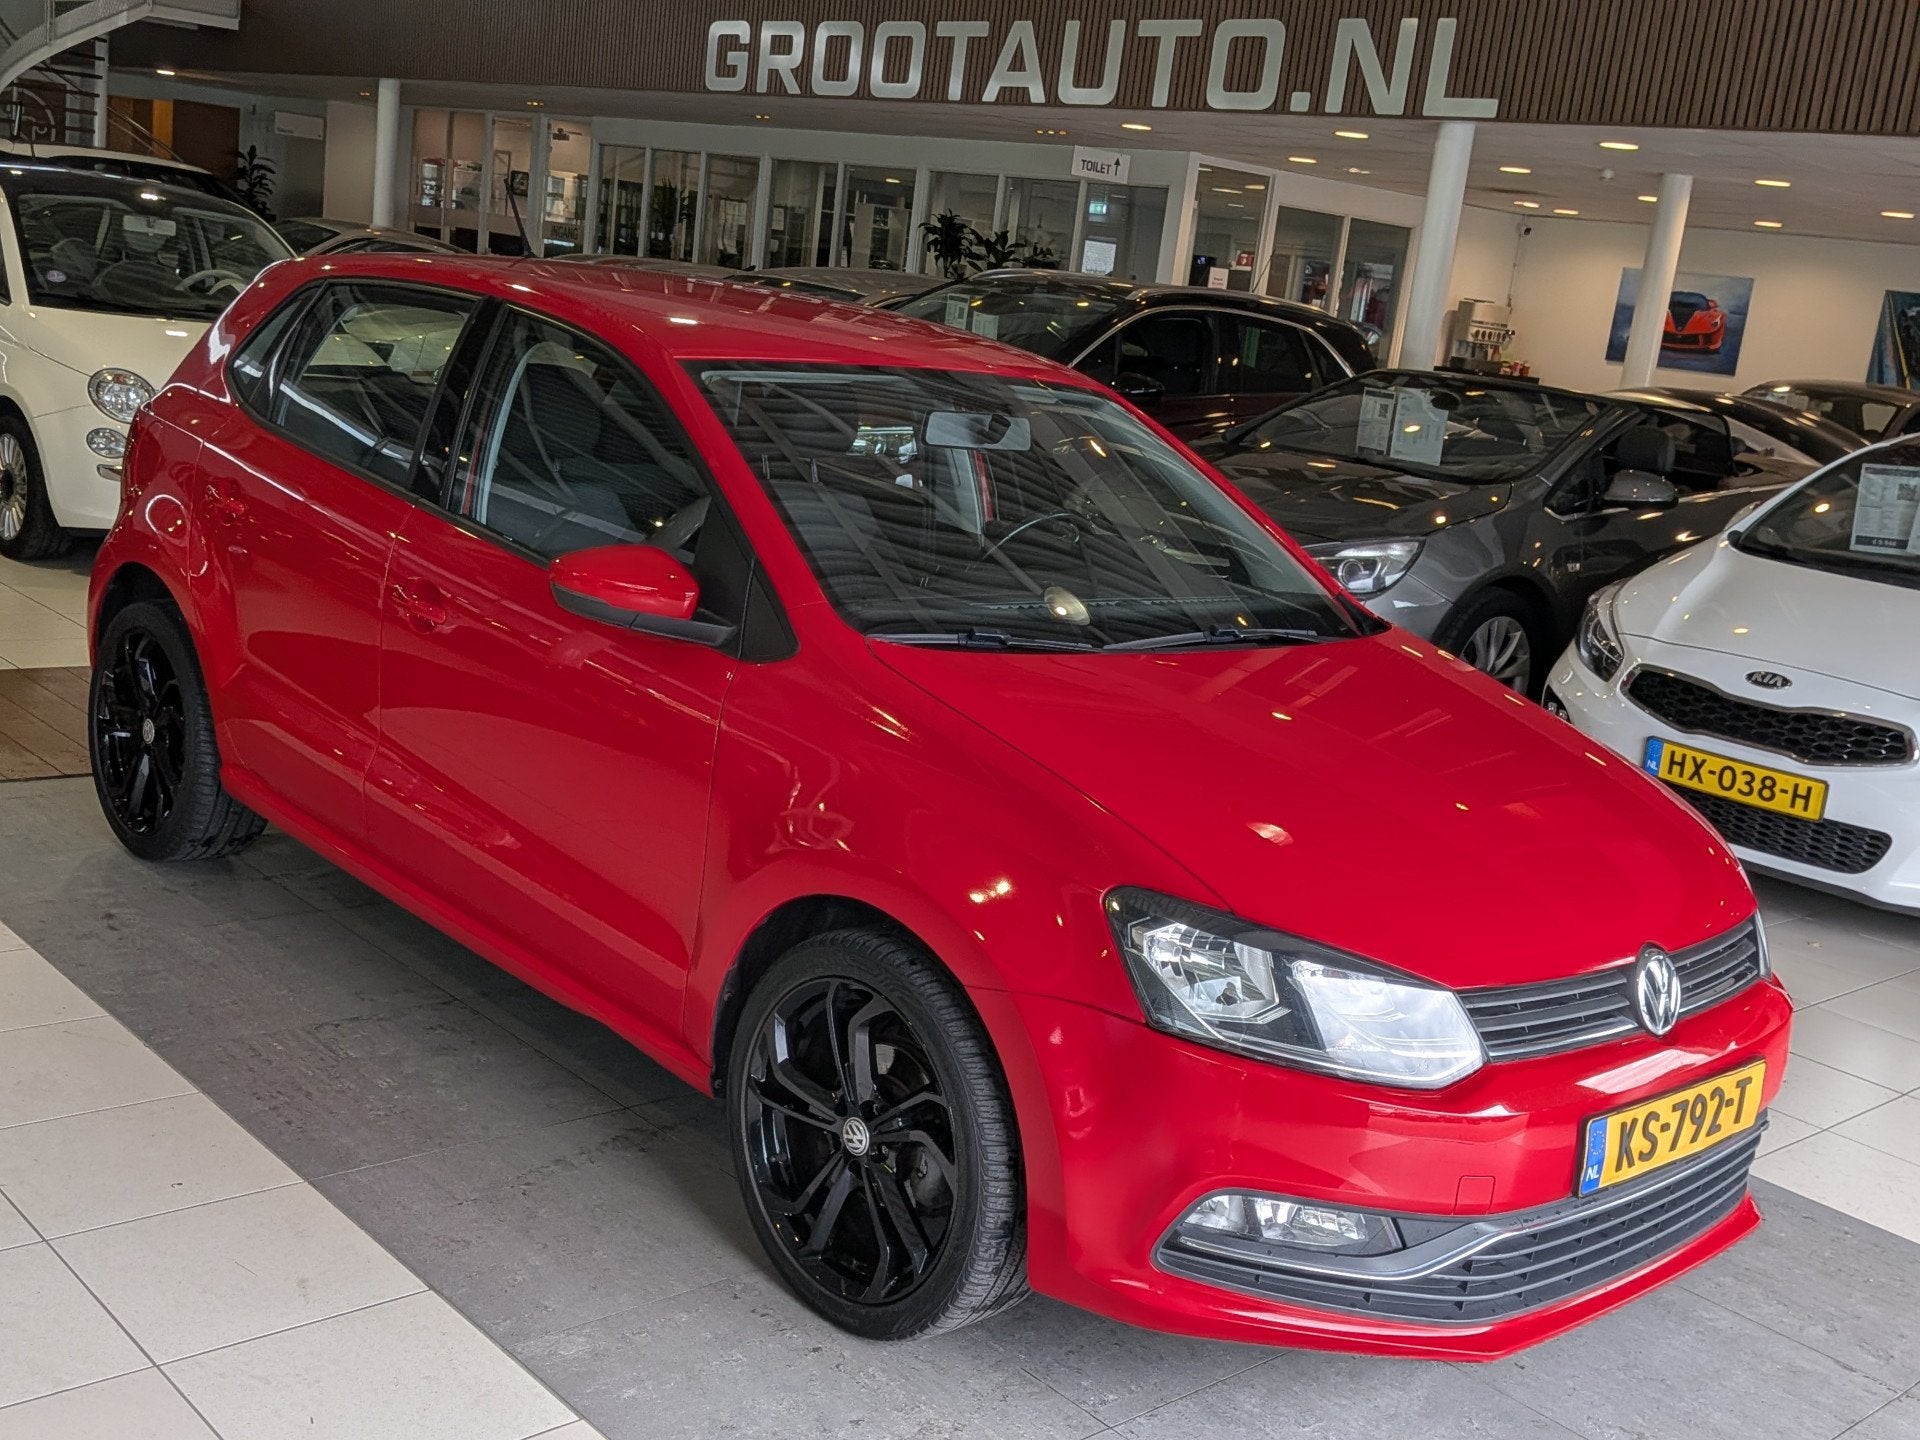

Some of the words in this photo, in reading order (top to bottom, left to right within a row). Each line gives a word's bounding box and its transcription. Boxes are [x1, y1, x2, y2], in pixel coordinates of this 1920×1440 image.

[705, 17, 1499, 119] GROOTAUTO.NL
[1081, 159, 1111, 174] TOILET
[1751, 672, 1783, 687] KIA
[1647, 760, 1658, 771] NL
[1667, 750, 1812, 812] HX-038-H
[1586, 1165, 1600, 1181] NL
[1615, 1076, 1753, 1173] KS-792-T
